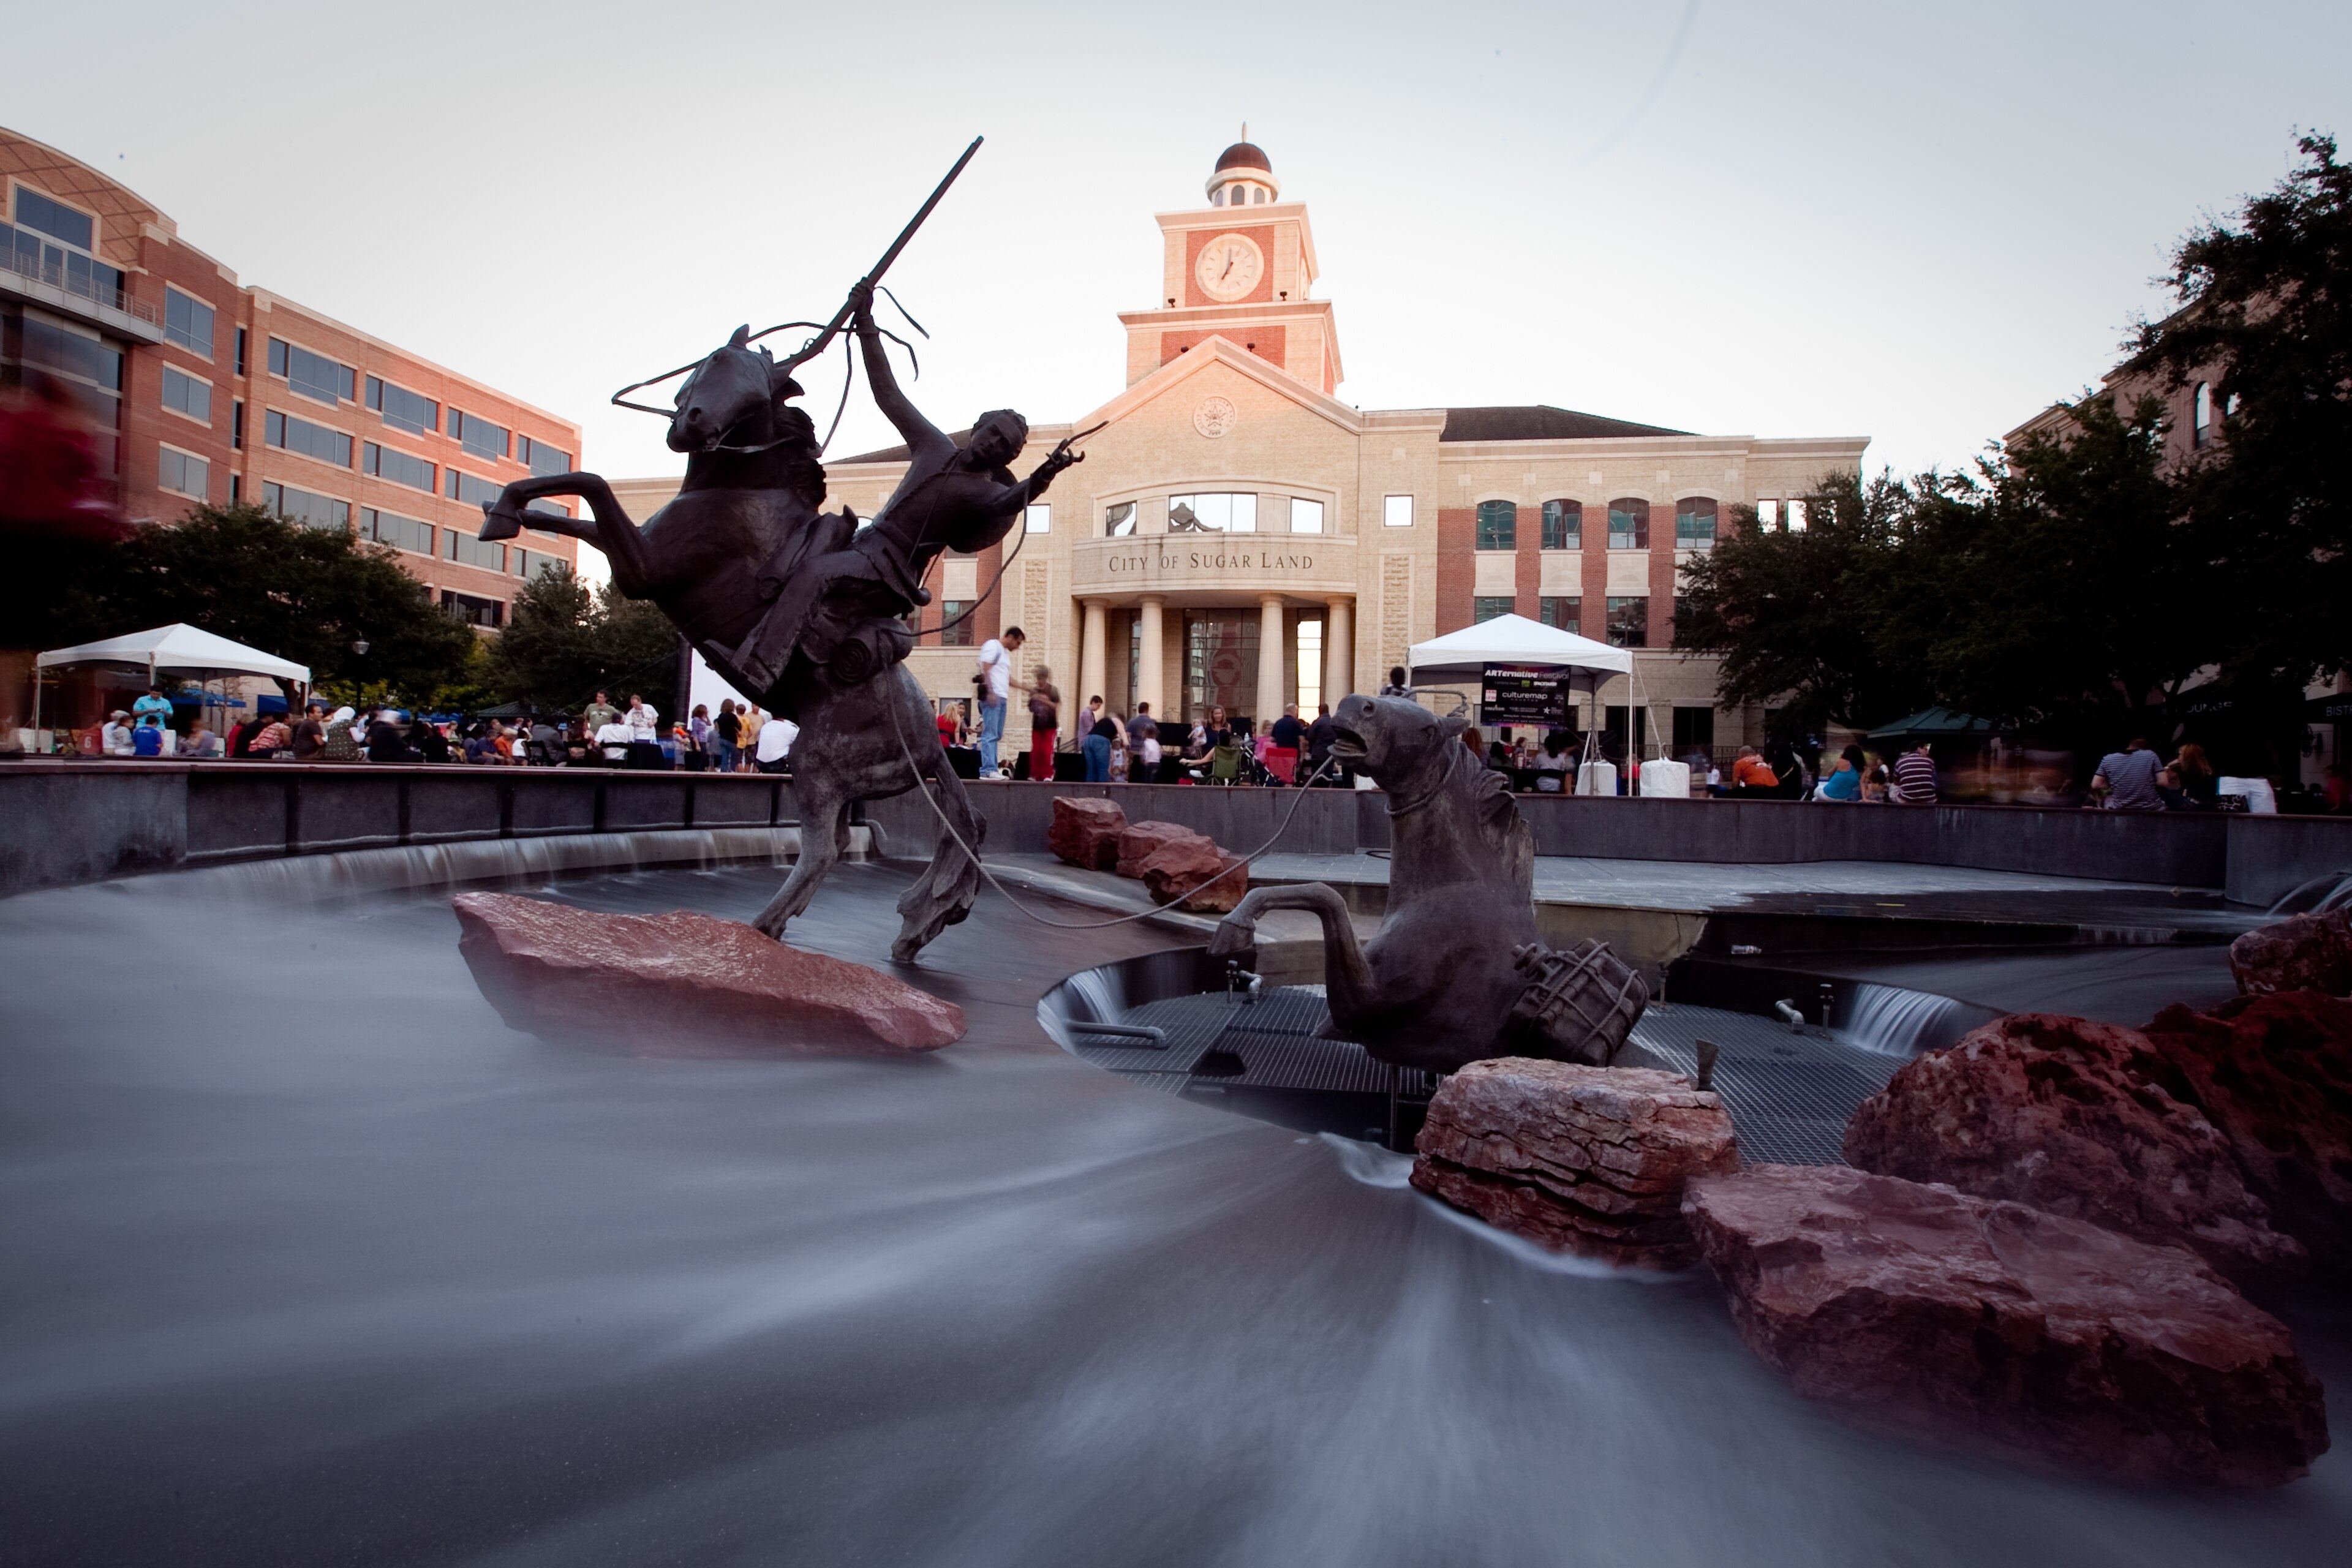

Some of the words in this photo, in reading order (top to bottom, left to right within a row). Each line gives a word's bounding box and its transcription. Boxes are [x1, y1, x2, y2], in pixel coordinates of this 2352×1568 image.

[1109, 556, 1148, 571] CITY
[1160, 556, 1178, 569] OF
[1190, 552, 1251, 568] SUGAR
[1261, 552, 1313, 569] LAND
[1484, 669, 1539, 678] ARTernative
[1539, 671, 1569, 679] Festival
[1502, 692, 1548, 700] culturemap
